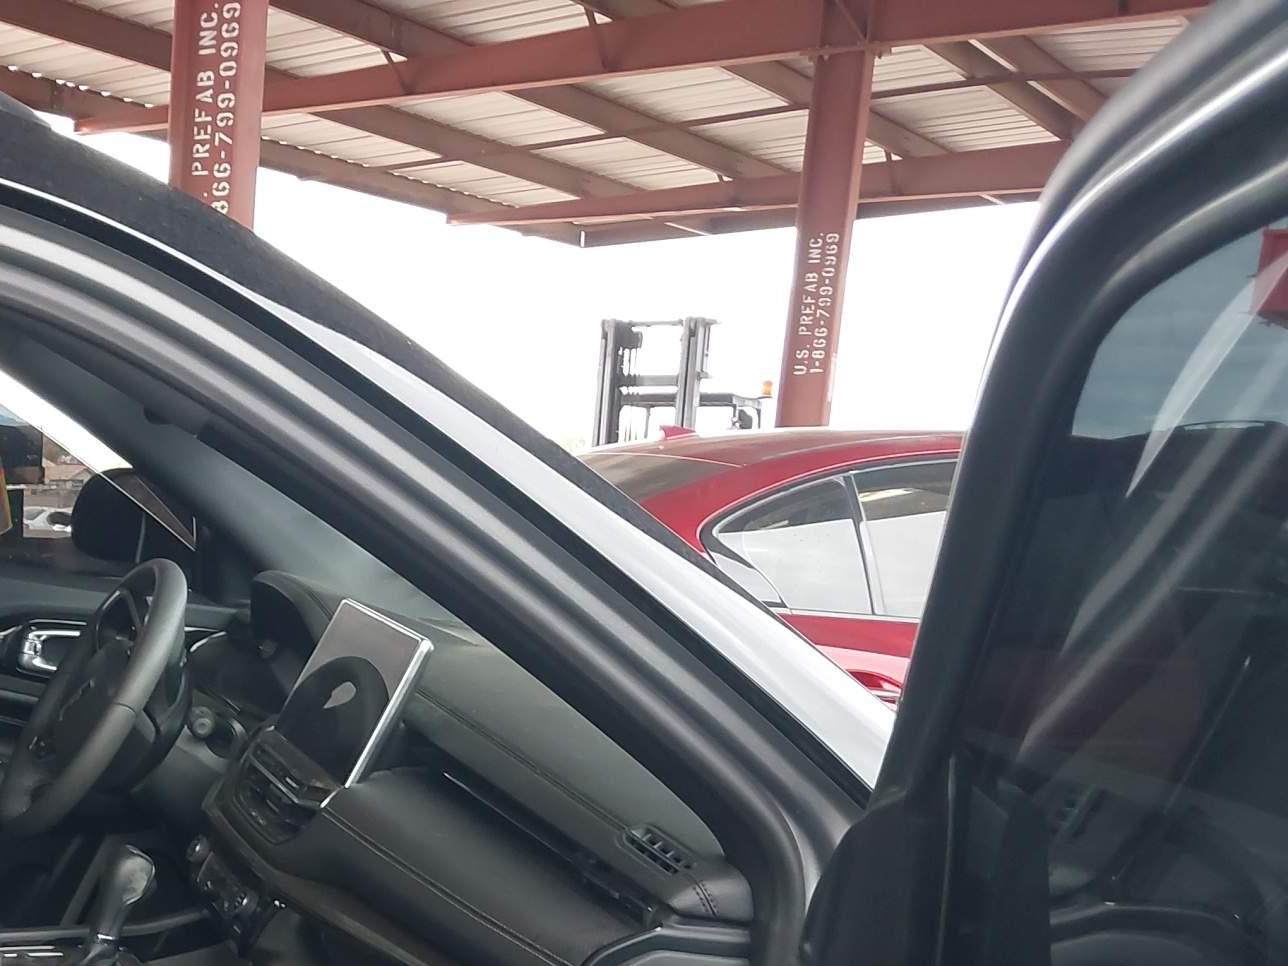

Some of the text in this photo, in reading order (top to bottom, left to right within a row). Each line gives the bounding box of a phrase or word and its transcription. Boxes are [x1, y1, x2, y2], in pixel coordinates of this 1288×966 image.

[192, 2, 220, 176] PREFAB INC.
[793, 232, 825, 375] U.S. PREFAB INC.
[809, 232, 840, 374] 1-866-799-0969
